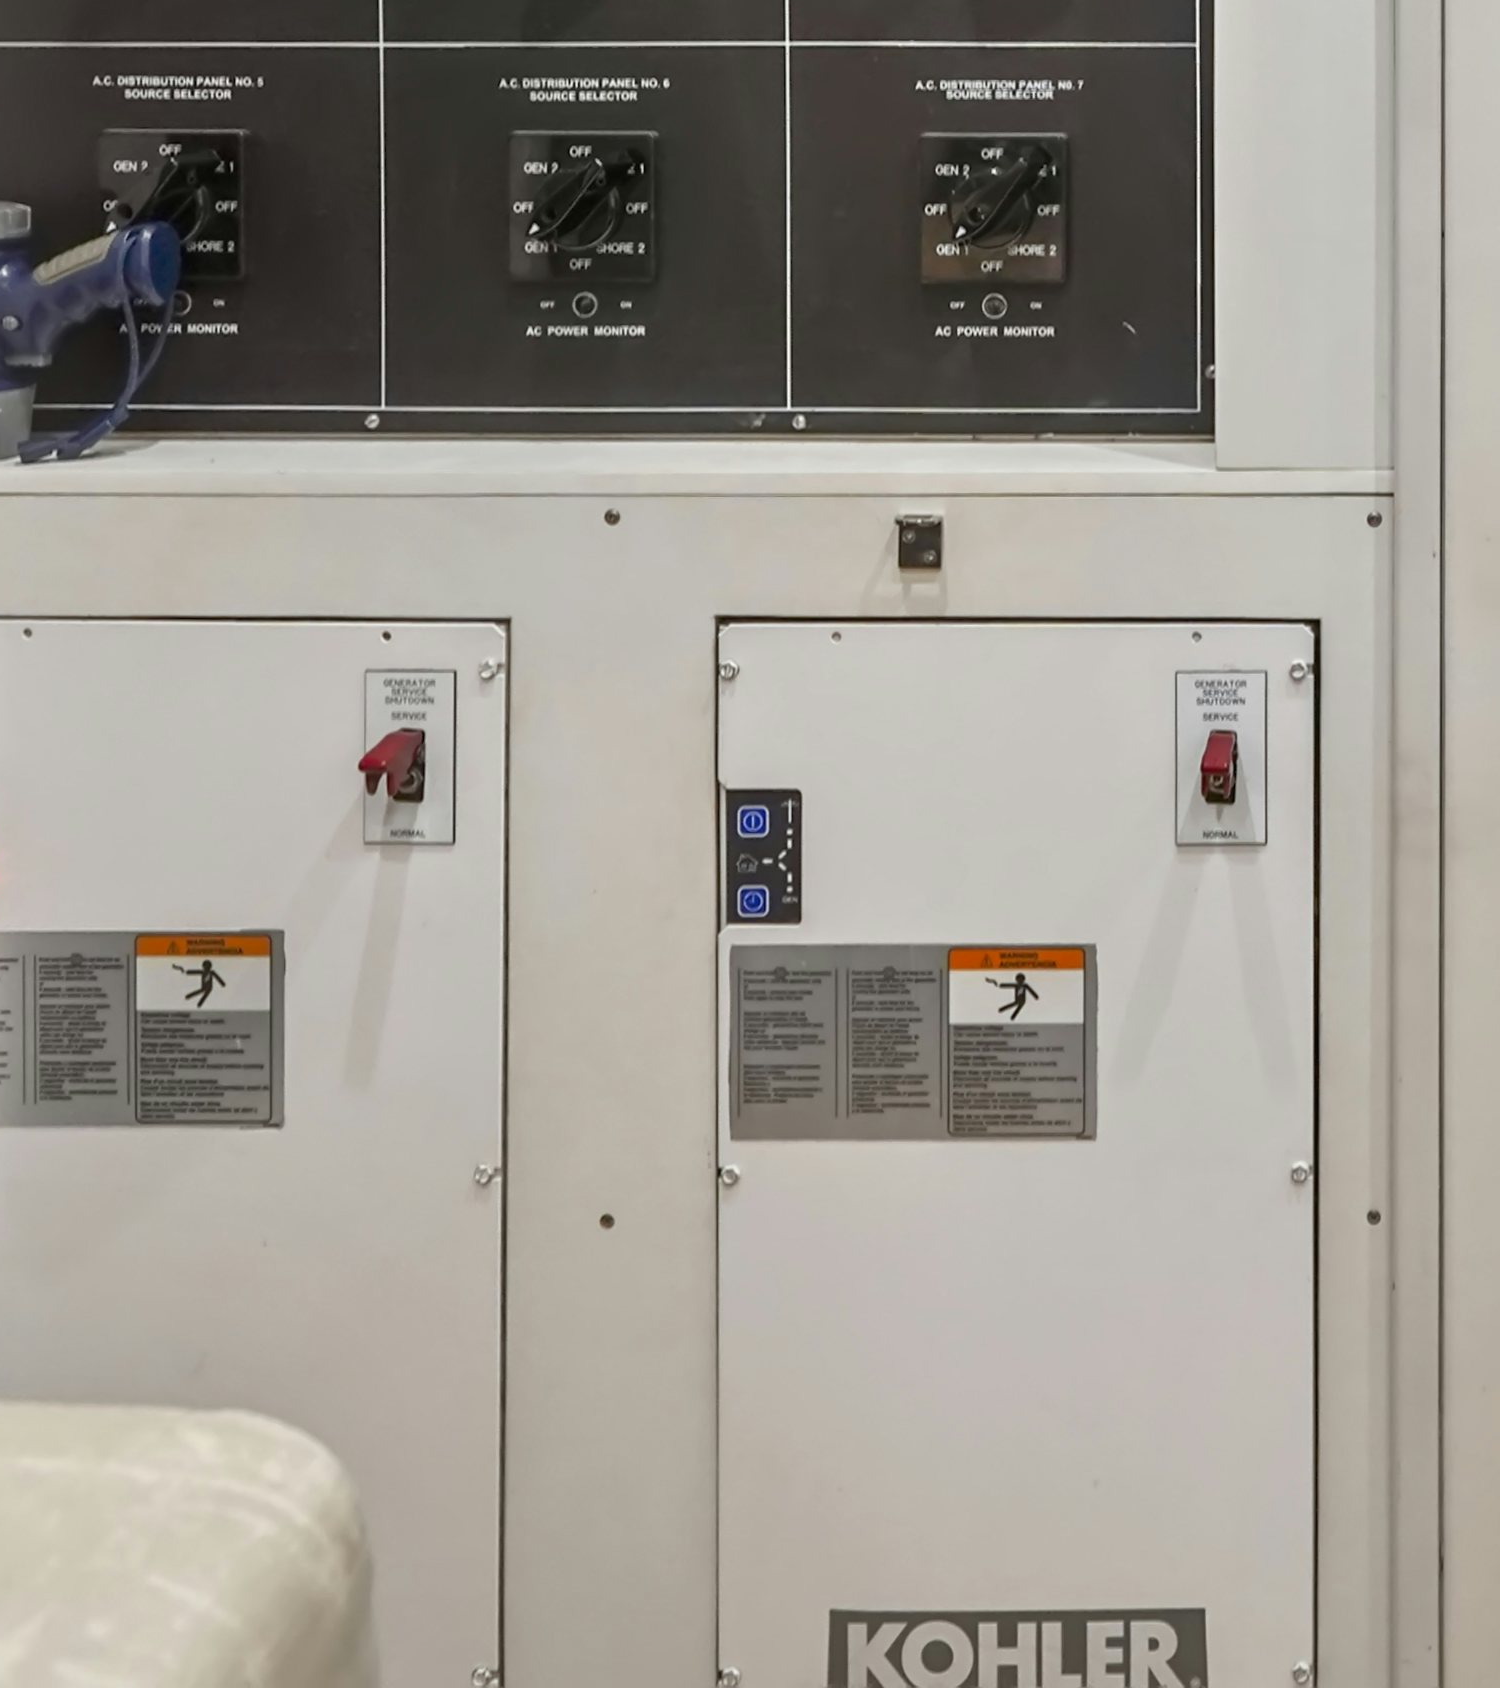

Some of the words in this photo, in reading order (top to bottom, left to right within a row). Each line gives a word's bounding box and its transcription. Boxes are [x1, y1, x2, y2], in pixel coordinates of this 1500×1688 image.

[1195, 680, 1246, 689] GENERATOR
[1203, 688, 1237, 697] SERVICE
[847, 1620, 1184, 1688] KOHLER
